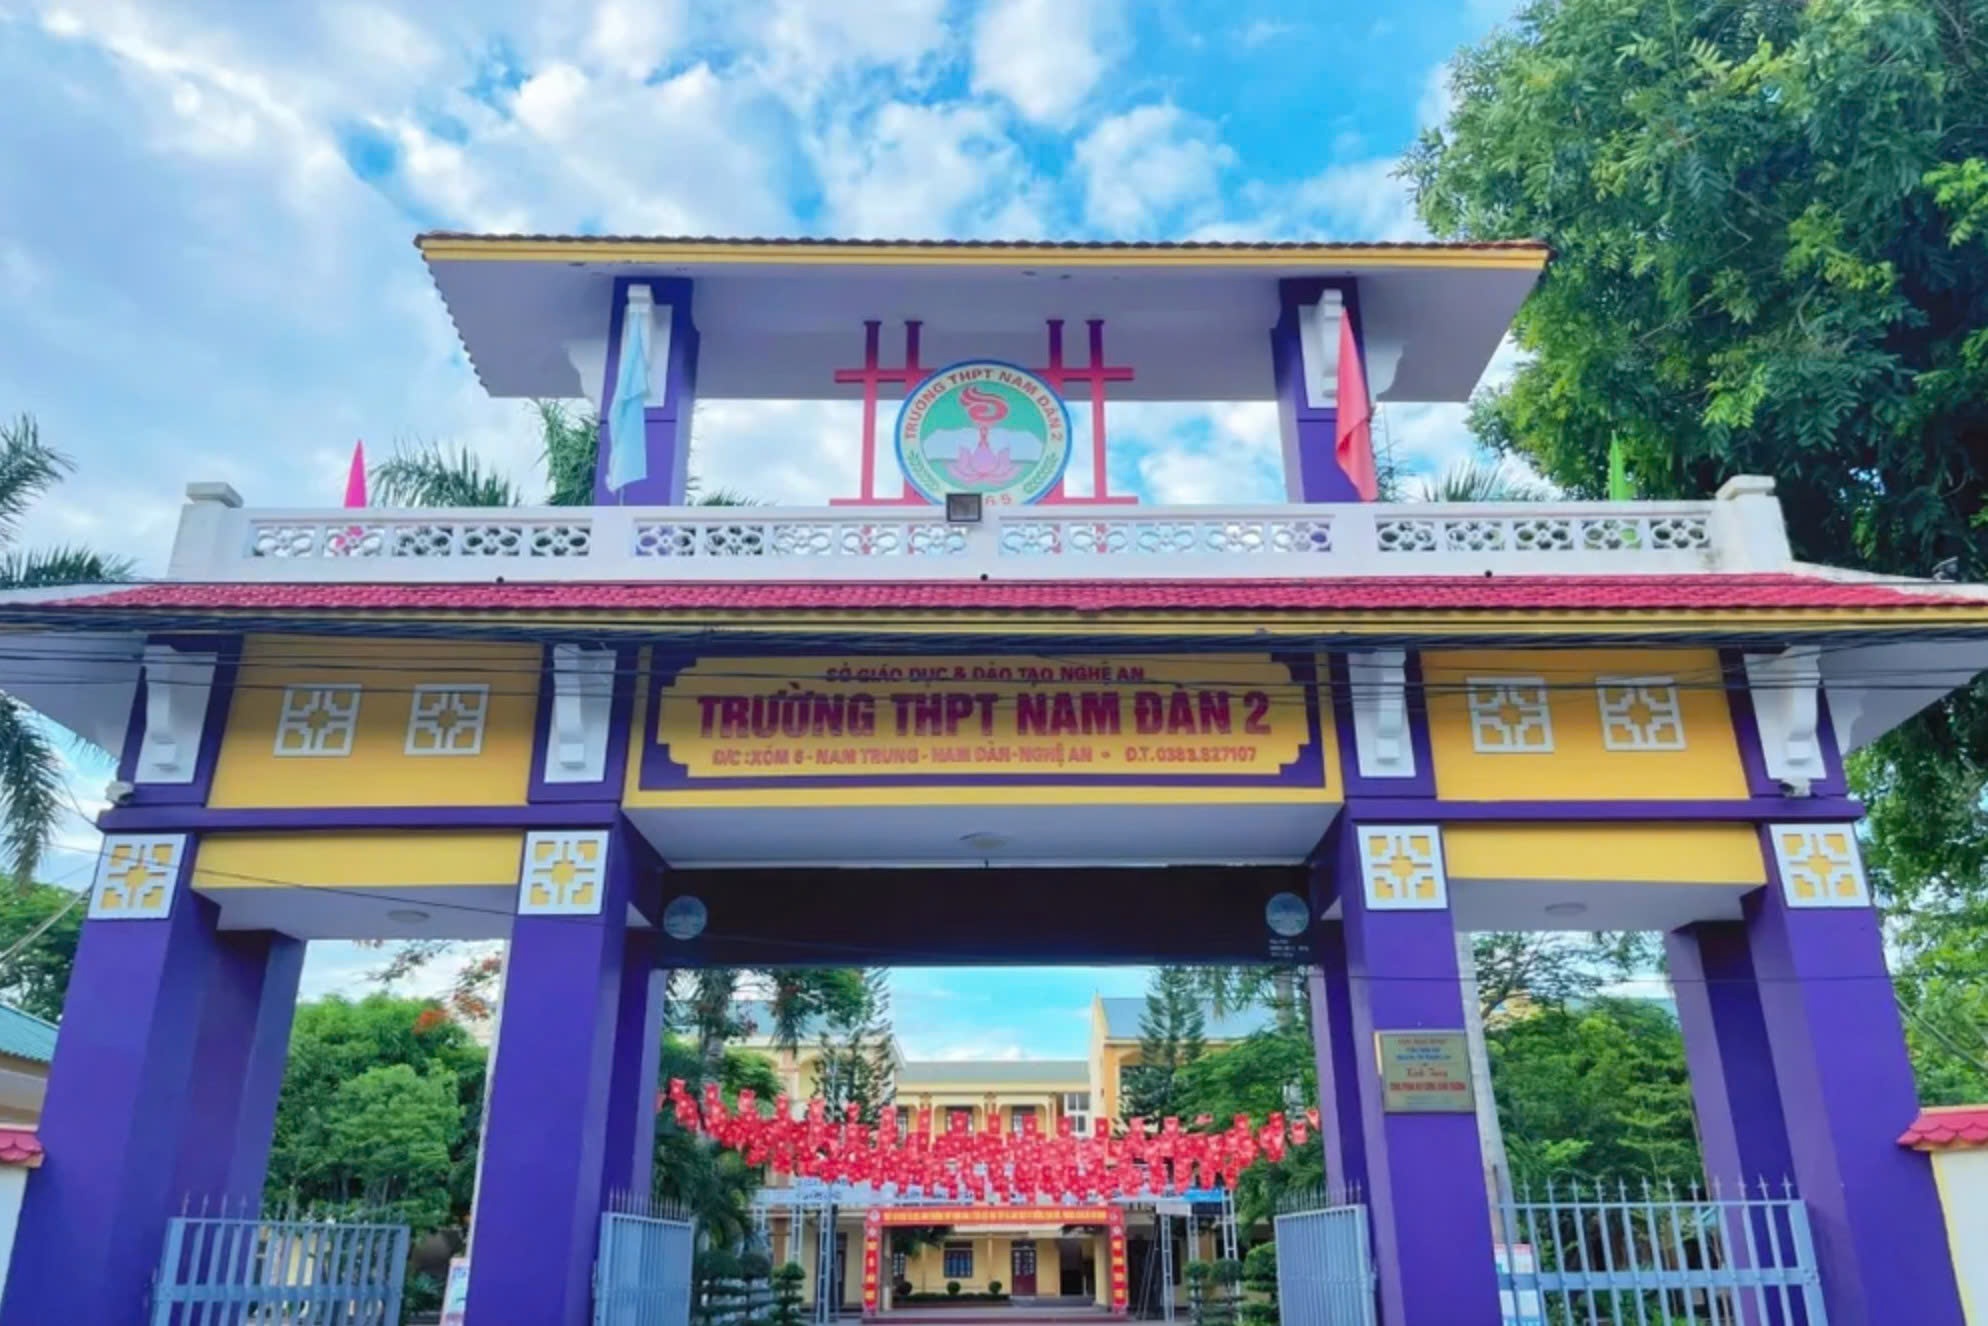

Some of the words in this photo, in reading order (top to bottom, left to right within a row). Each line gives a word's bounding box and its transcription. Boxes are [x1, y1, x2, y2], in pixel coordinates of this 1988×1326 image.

[947, 367, 993, 385] THPT
[999, 370, 1038, 395] NAM
[953, 665, 967, 680] &
[1116, 666, 1145, 681] AN
[697, 681, 876, 739] TRƯỜNG
[890, 691, 999, 737] THPT
[1016, 690, 1121, 736] NAM
[1133, 683, 1232, 736] ĐÀN
[1243, 690, 1273, 736] 2
[815, 748, 857, 765] NAM
[859, 746, 919, 765] TRUNG
[1068, 745, 1093, 763] AN
